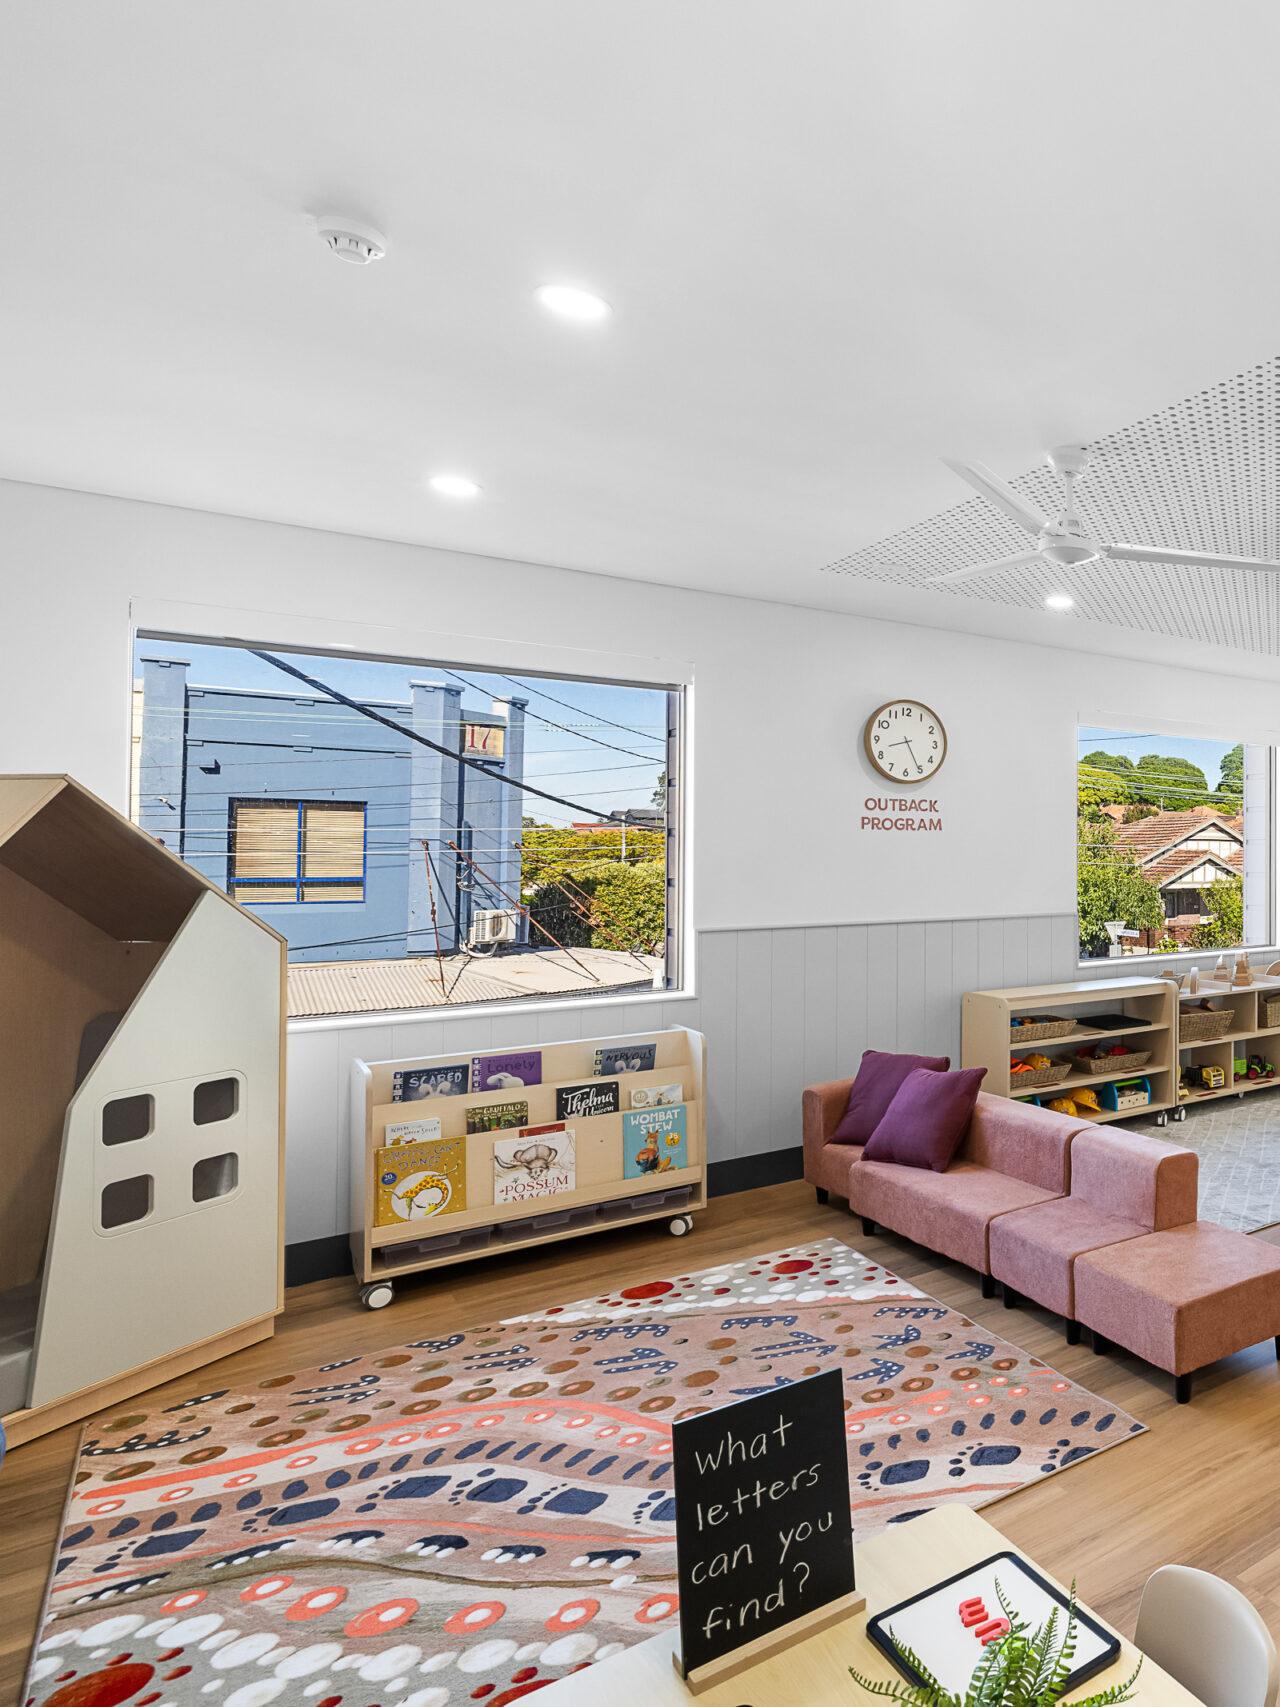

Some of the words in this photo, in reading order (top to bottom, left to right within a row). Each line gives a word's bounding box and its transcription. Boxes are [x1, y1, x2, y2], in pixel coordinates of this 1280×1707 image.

[902, 707, 912, 717] 12
[878, 719, 890, 729] 10
[928, 725, 935, 735] 2
[873, 735, 880, 744] 9
[932, 740, 938, 750] 3
[877, 751, 884, 760] 8
[927, 755, 934, 764] 4
[888, 762, 895, 772] 7
[902, 768, 909, 777] 6
[917, 765, 924, 774] 5
[864, 797, 939, 812] OUTBACK
[861, 816, 943, 831] PROGRAM
[487, 1060, 536, 1073] Lonely
[408, 1072, 463, 1087] SCARED
[563, 1088, 614, 1112] Thelma
[630, 1109, 681, 1126] WOMBAT
[640, 1121, 673, 1134] STEW
[505, 1175, 569, 1195] POSSUM
[694, 1413, 794, 1476] What
[696, 1462, 822, 1532] letters
[690, 1541, 753, 1585] can
[778, 1510, 834, 1565] you
